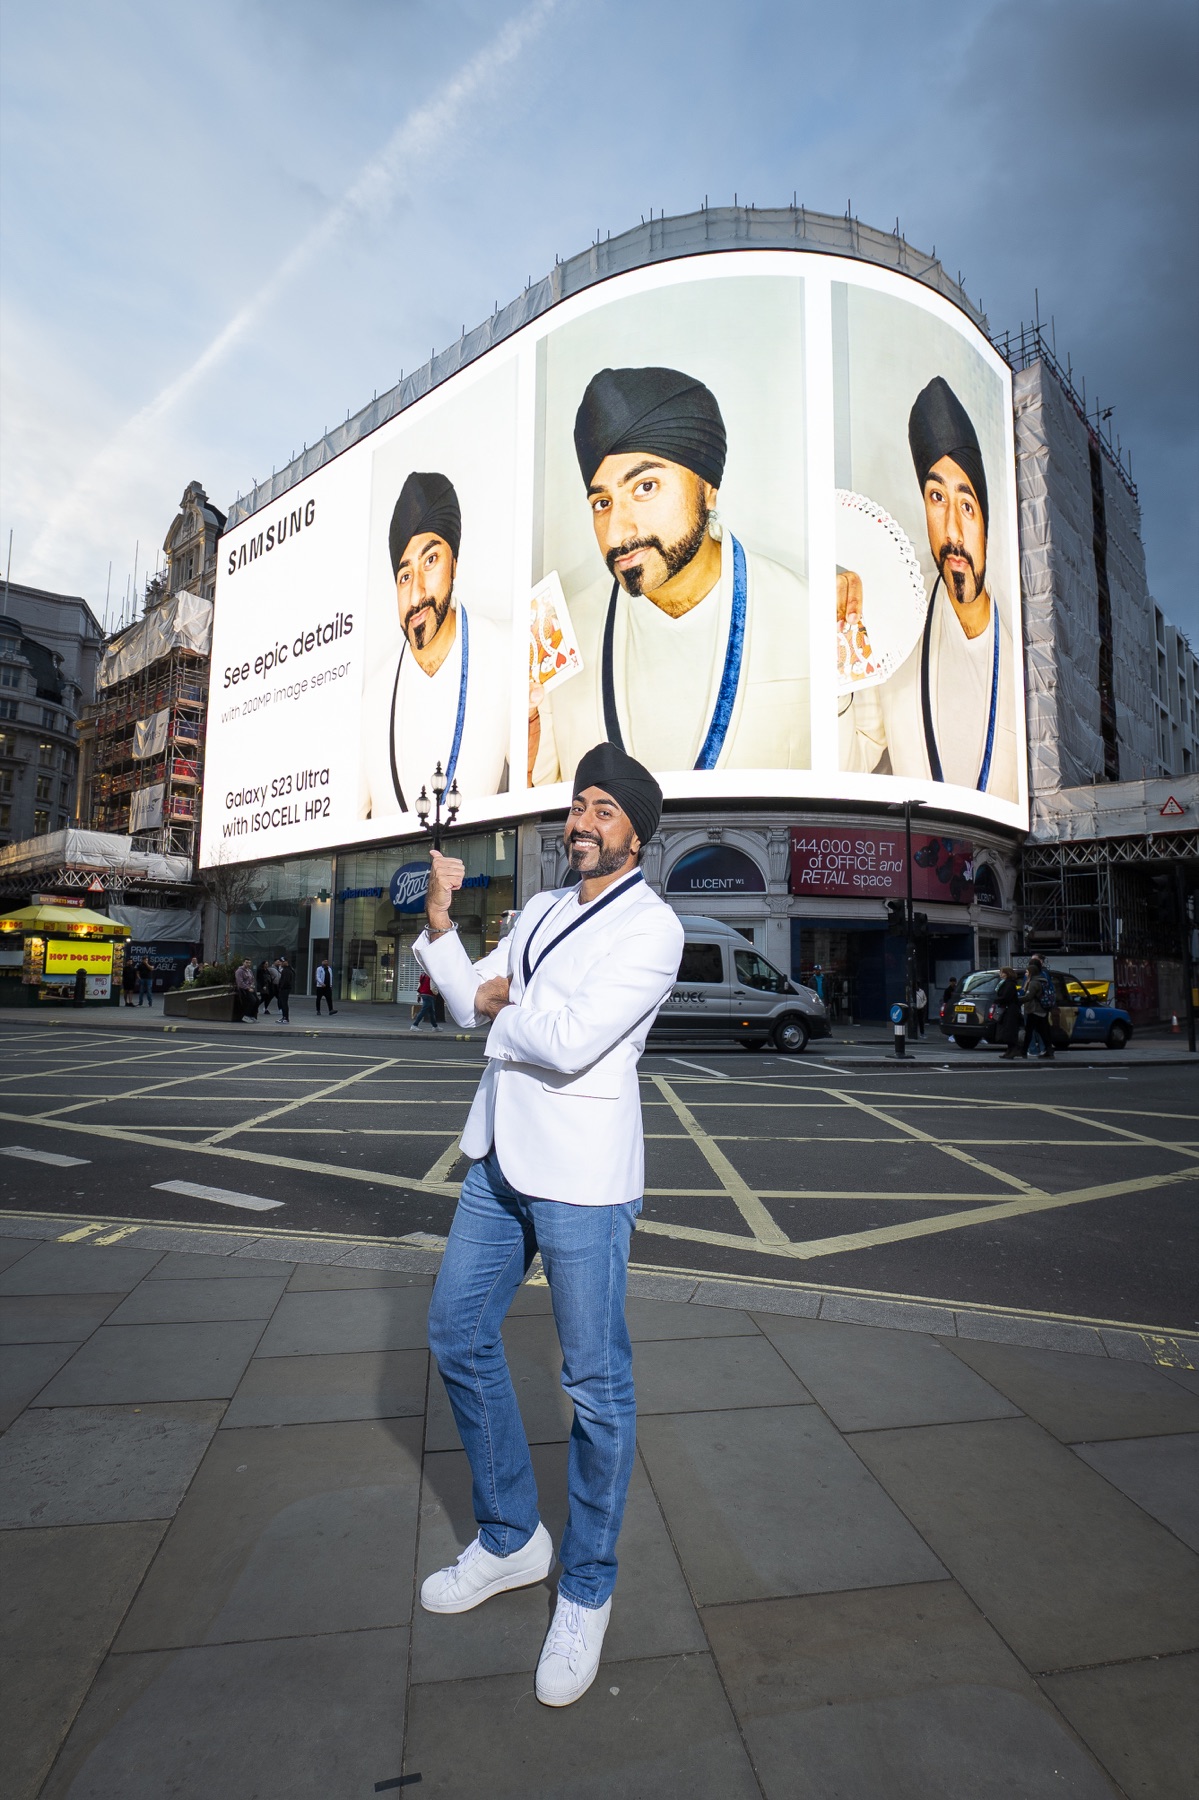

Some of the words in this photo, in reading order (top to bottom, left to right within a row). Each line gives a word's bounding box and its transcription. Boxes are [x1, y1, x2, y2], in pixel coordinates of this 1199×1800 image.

[228, 499, 315, 576] SAMSUNG
[223, 662, 250, 689] See
[254, 641, 288, 680] epic
[292, 612, 354, 658] details
[221, 705, 241, 724] with
[242, 692, 272, 716] 200MP
[273, 679, 309, 700] image
[310, 661, 352, 689] sensor
[225, 784, 268, 809] Galaxy
[271, 775, 293, 798] S23
[296, 768, 330, 792] Ultra
[222, 816, 249, 838] with
[251, 804, 301, 833] ISOCELL
[304, 796, 331, 822] HP2
[792, 838, 852, 855] 144,000
[855, 840, 876, 856] SQ
[879, 842, 896, 856] FT
[809, 855, 823, 868] of
[826, 855, 877, 871] OFFICE
[880, 859, 903, 872] and
[339, 887, 384, 904] pharmacy
[461, 873, 491, 889] eauty
[690, 878, 734, 889] LUCENT
[801, 869, 850, 885] RETAIL
[853, 874, 893, 888] space
[49, 953, 68, 961] HOT
[130, 946, 157, 954] PRIME
